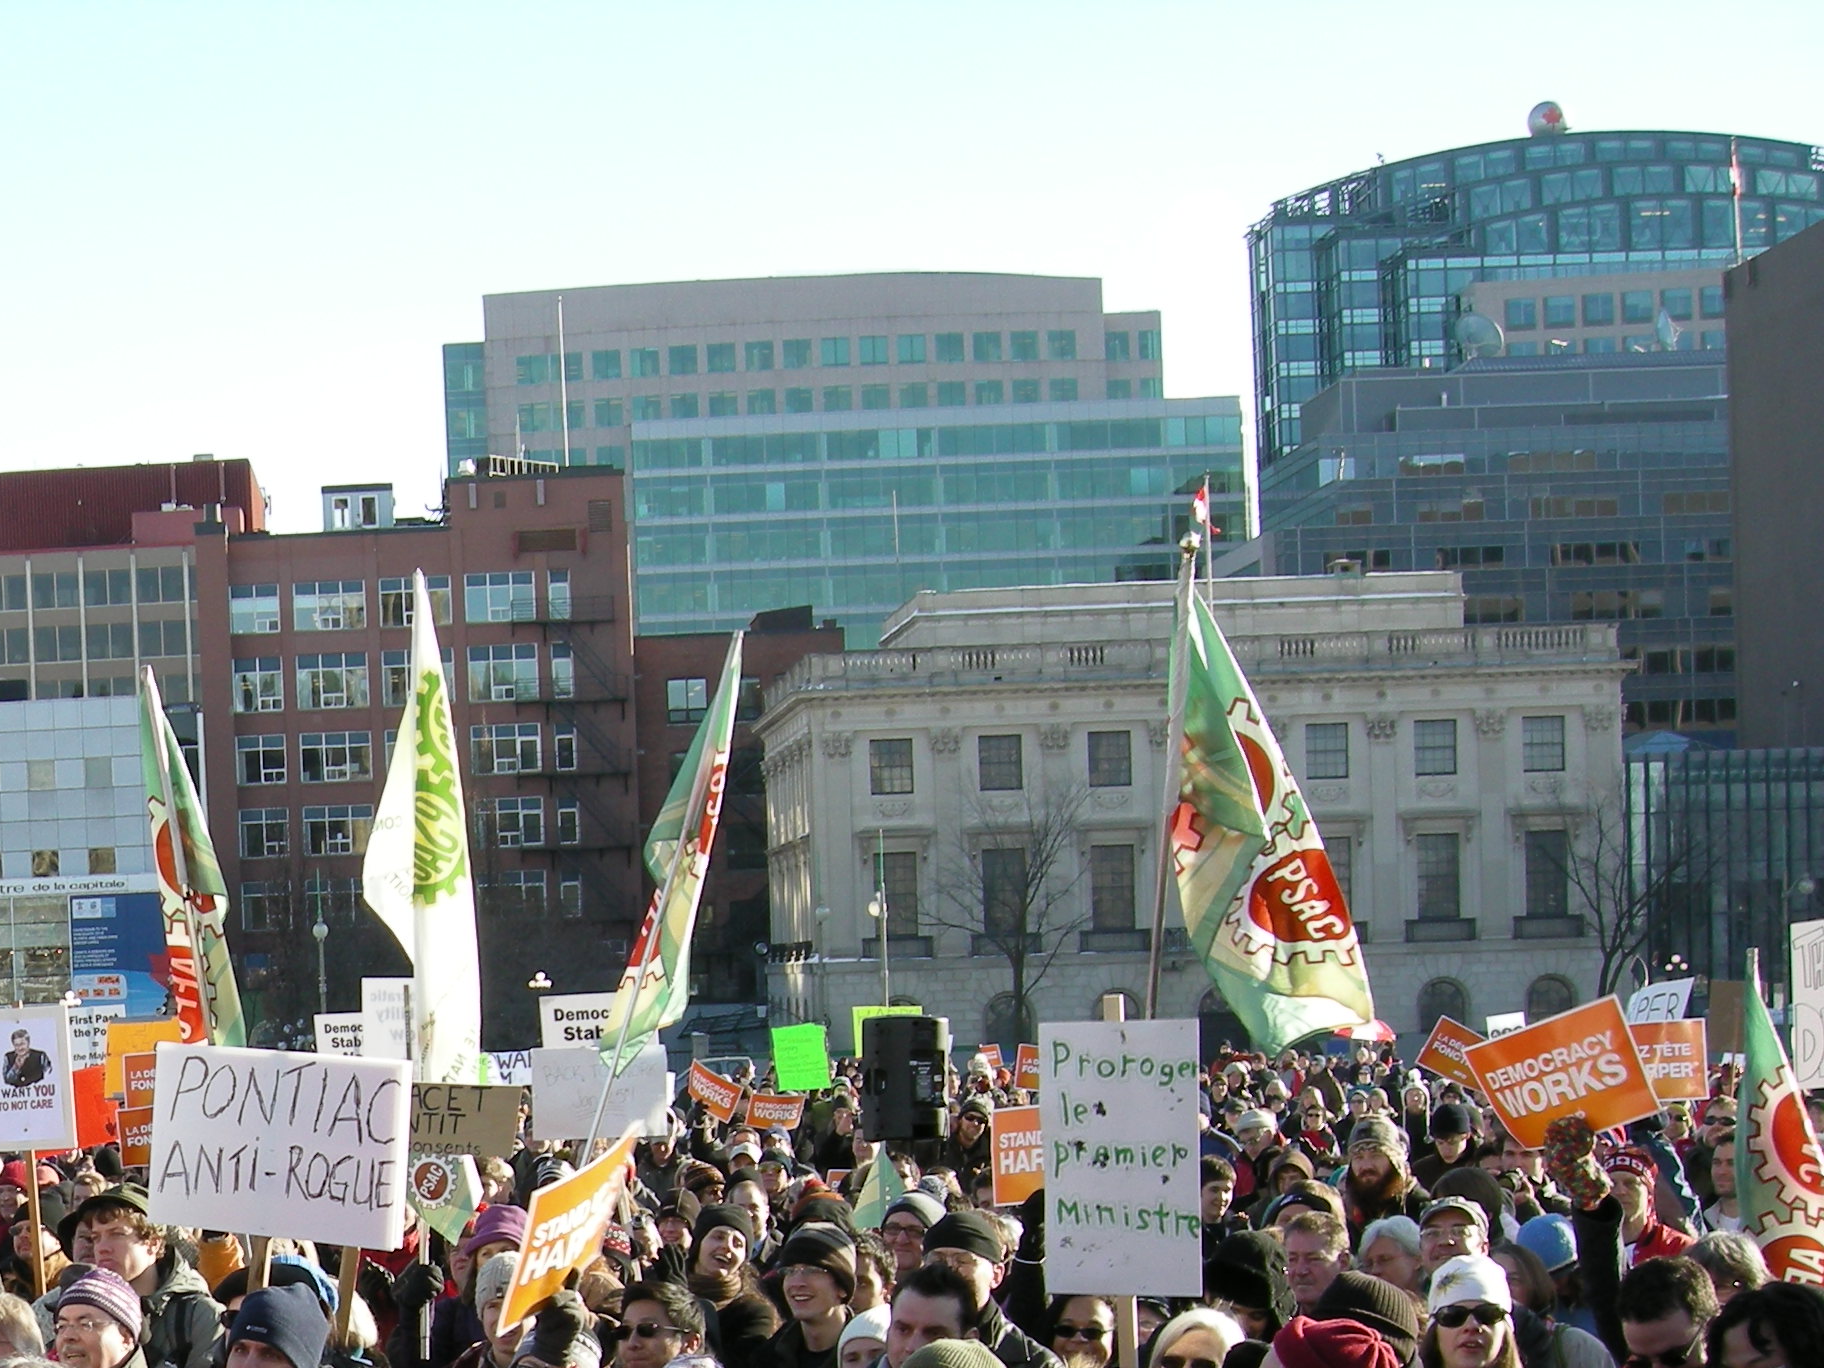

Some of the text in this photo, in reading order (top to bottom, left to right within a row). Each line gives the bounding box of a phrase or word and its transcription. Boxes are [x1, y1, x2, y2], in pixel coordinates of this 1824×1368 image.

[32, 882, 51, 892] de
[54, 881, 66, 891] la
[69, 879, 126, 891] capitale
[1267, 849, 1345, 942] PSAC
[68, 1015, 93, 1025] First
[553, 1007, 610, 1022] Democ
[73, 1027, 107, 1038] the Po
[324, 1023, 364, 1034] Democ
[1653, 1041, 1693, 1057] TÊTE
[1052, 1040, 1198, 1087] Proroger
[1485, 1030, 1614, 1091] DEMOCRACY
[130, 1070, 143, 1079] LA
[1646, 1062, 1694, 1079] RPER
[0, 1086, 32, 1098] WANT
[33, 1083, 56, 1097] YOU
[693, 1069, 737, 1098] DEMOCRACY
[1495, 1053, 1627, 1119] WORKS
[170, 1055, 402, 1146] PONTIAC
[692, 1079, 732, 1109] WORKS
[10, 1100, 28, 1110] NOT
[30, 1098, 54, 1109] CARE
[754, 1101, 801, 1110] DEMOCRACY
[1061, 1091, 1089, 1126] le
[753, 1108, 798, 1119] WORKS
[125, 1126, 139, 1136] LA
[412, 1141, 481, 1155] onsents
[419, 1164, 444, 1198] PSAC
[532, 1198, 592, 1249] STAND
[1056, 1197, 1202, 1239] Ministre
